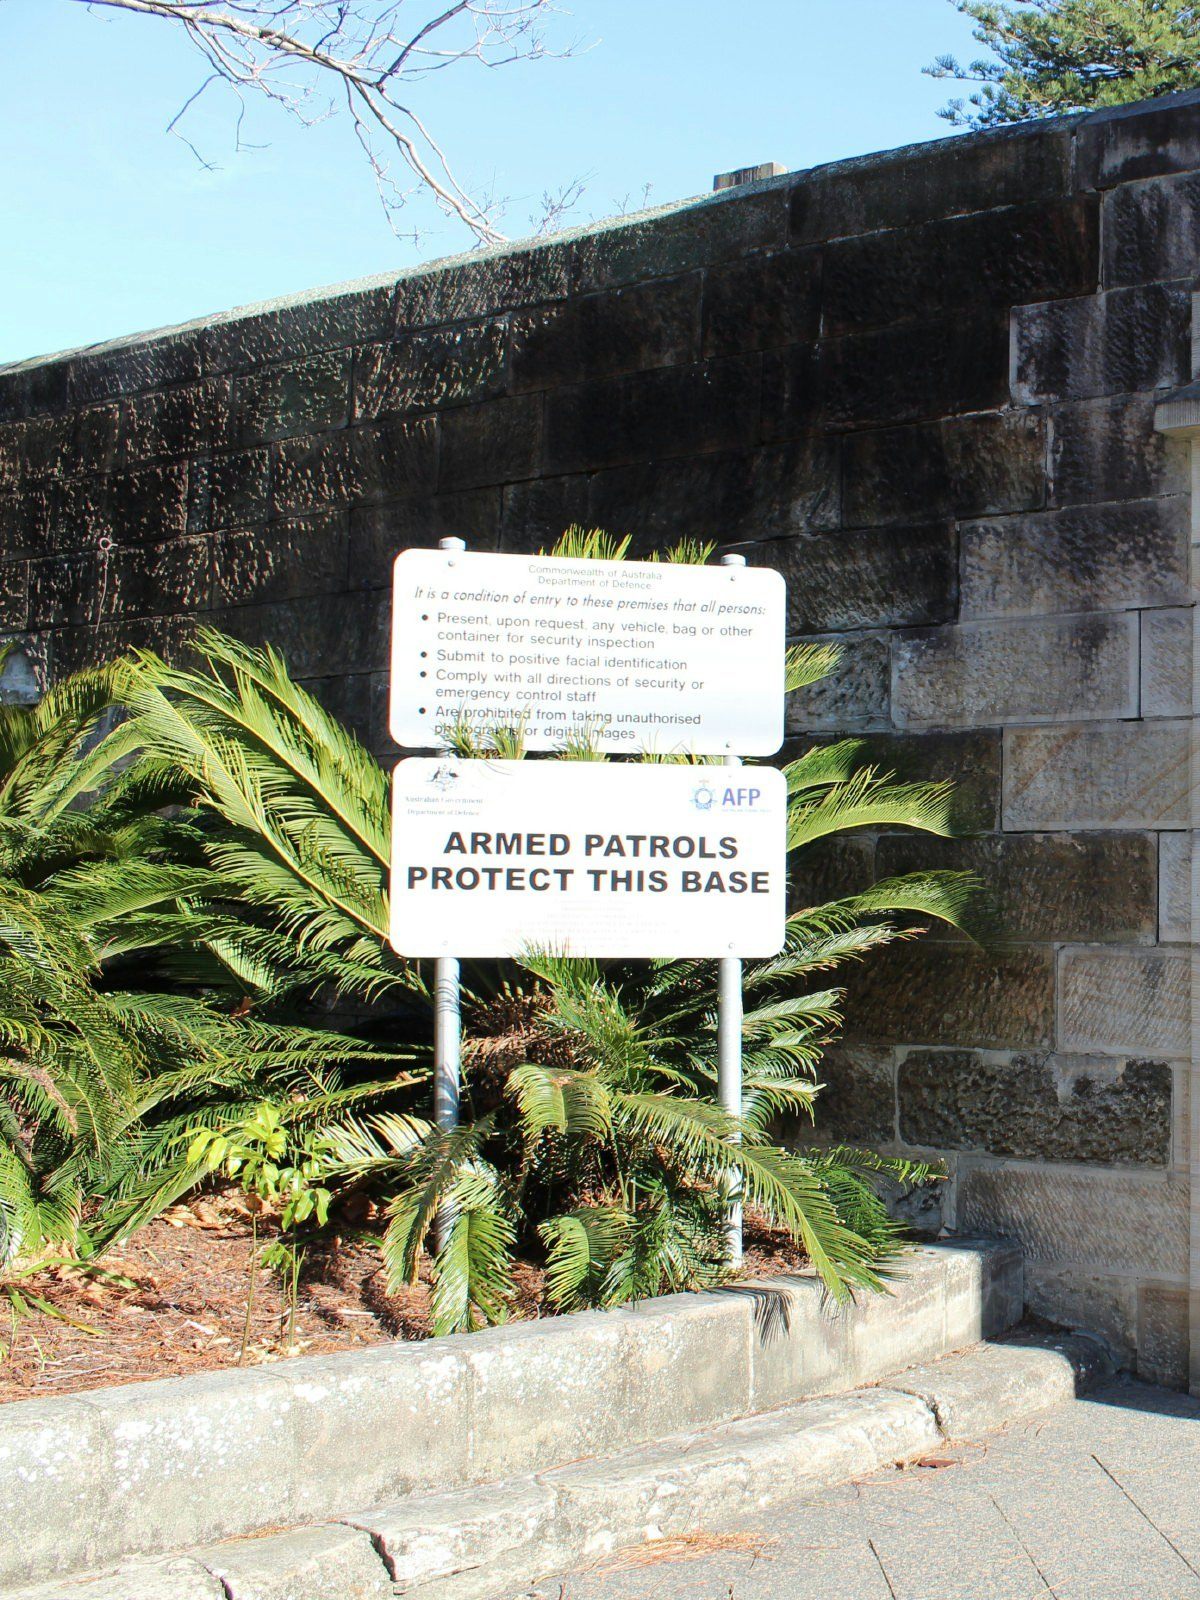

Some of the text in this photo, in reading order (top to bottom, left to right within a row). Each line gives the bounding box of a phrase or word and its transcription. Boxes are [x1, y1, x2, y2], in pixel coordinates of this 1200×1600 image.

[528, 564, 662, 581] Commonwealth of Australia
[538, 575, 652, 590] Department of Defence
[414, 586, 767, 617] It is a condition of entry to these premises that all persons:
[497, 616, 530, 629] upon
[592, 621, 615, 633] any
[672, 623, 697, 637] bag
[701, 626, 715, 636] or
[720, 625, 753, 638] other
[437, 630, 655, 650] container for security inspection
[437, 649, 687, 670] Submit to positive facial identification
[435, 668, 705, 692] Comply with all directions of security or
[435, 687, 597, 702] emergency control staff
[435, 705, 702, 725] Are prohibited from taking unauthorised
[434, 722, 519, 737] phtograhs
[524, 726, 538, 736] or
[543, 725, 585, 739] digital
[722, 788, 761, 806] AFP
[442, 831, 738, 859] ARMED PATROLS
[406, 866, 771, 894] PROTECT THIS BASE
